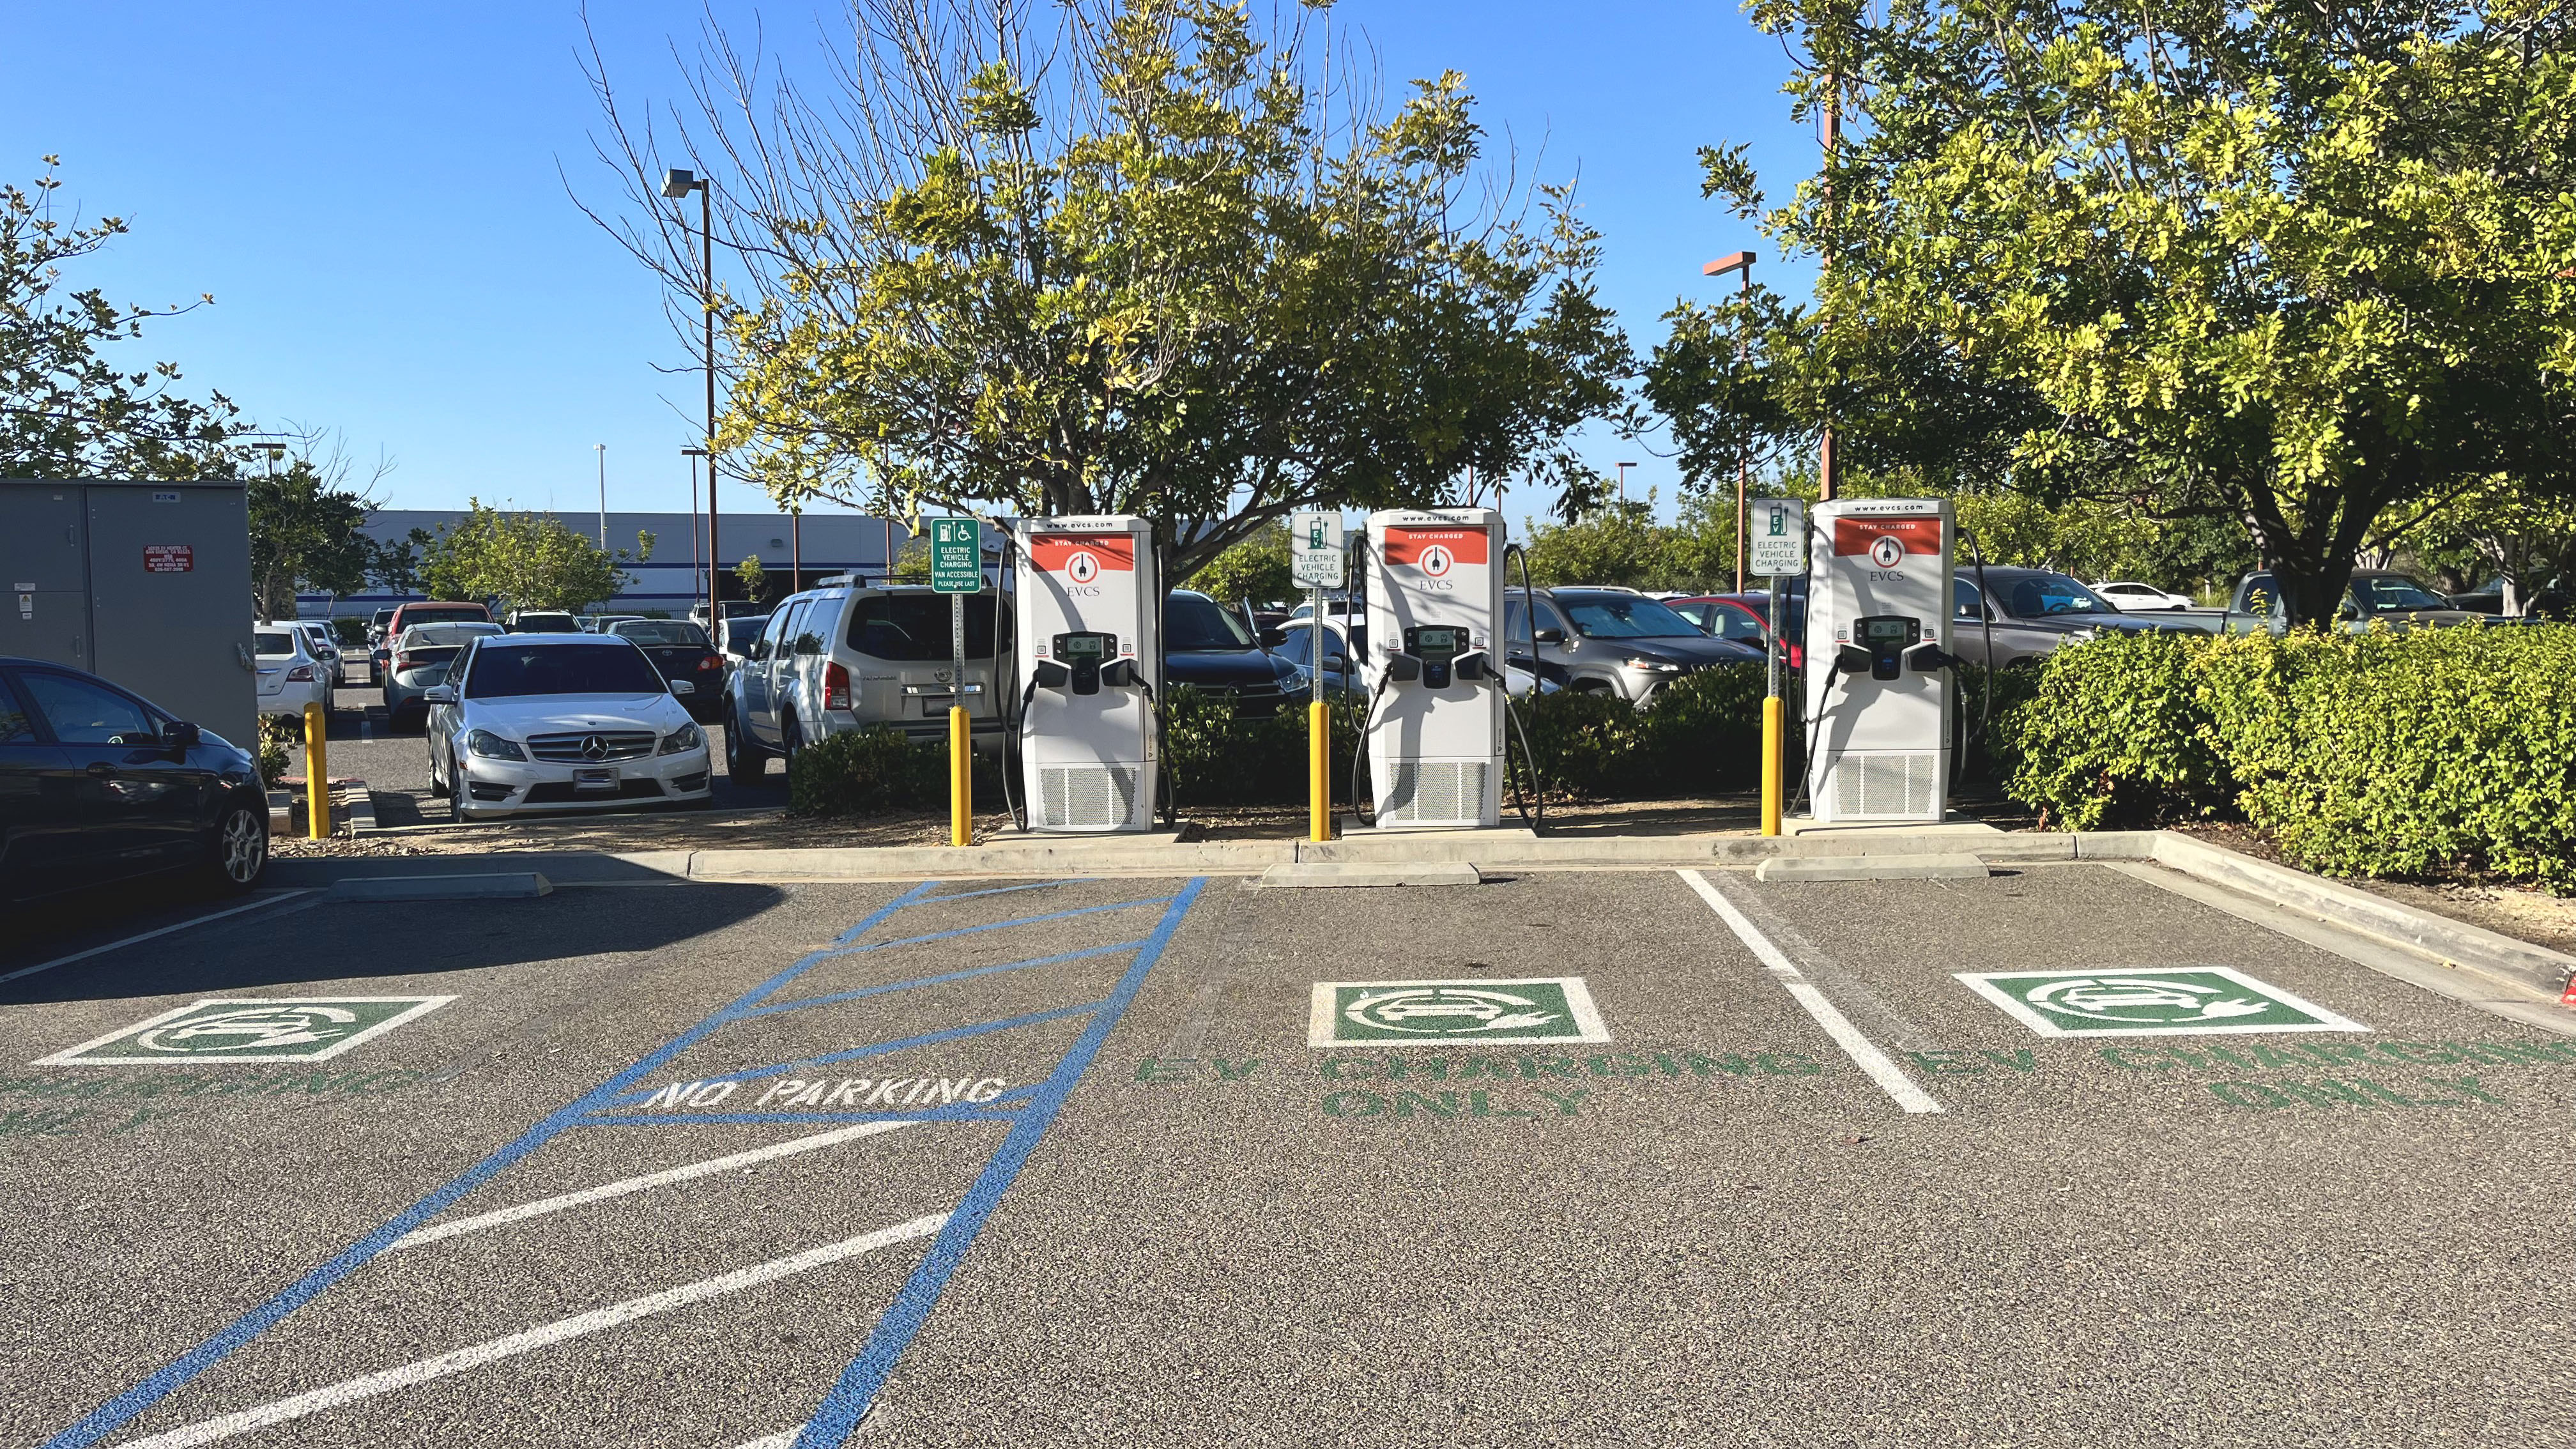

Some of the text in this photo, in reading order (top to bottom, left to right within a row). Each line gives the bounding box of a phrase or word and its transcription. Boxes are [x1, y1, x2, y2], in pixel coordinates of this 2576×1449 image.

[1755, 559, 1798, 567] CHARGING
[1870, 571, 1904, 581] EVCS
[1420, 579, 1453, 590] EVCS
[1067, 586, 1100, 597] EVCS
[1135, 1050, 1823, 1084] EV CHARGING
[643, 1077, 1005, 1108] NO PARKING
[1320, 1088, 1591, 1119] ONLY
